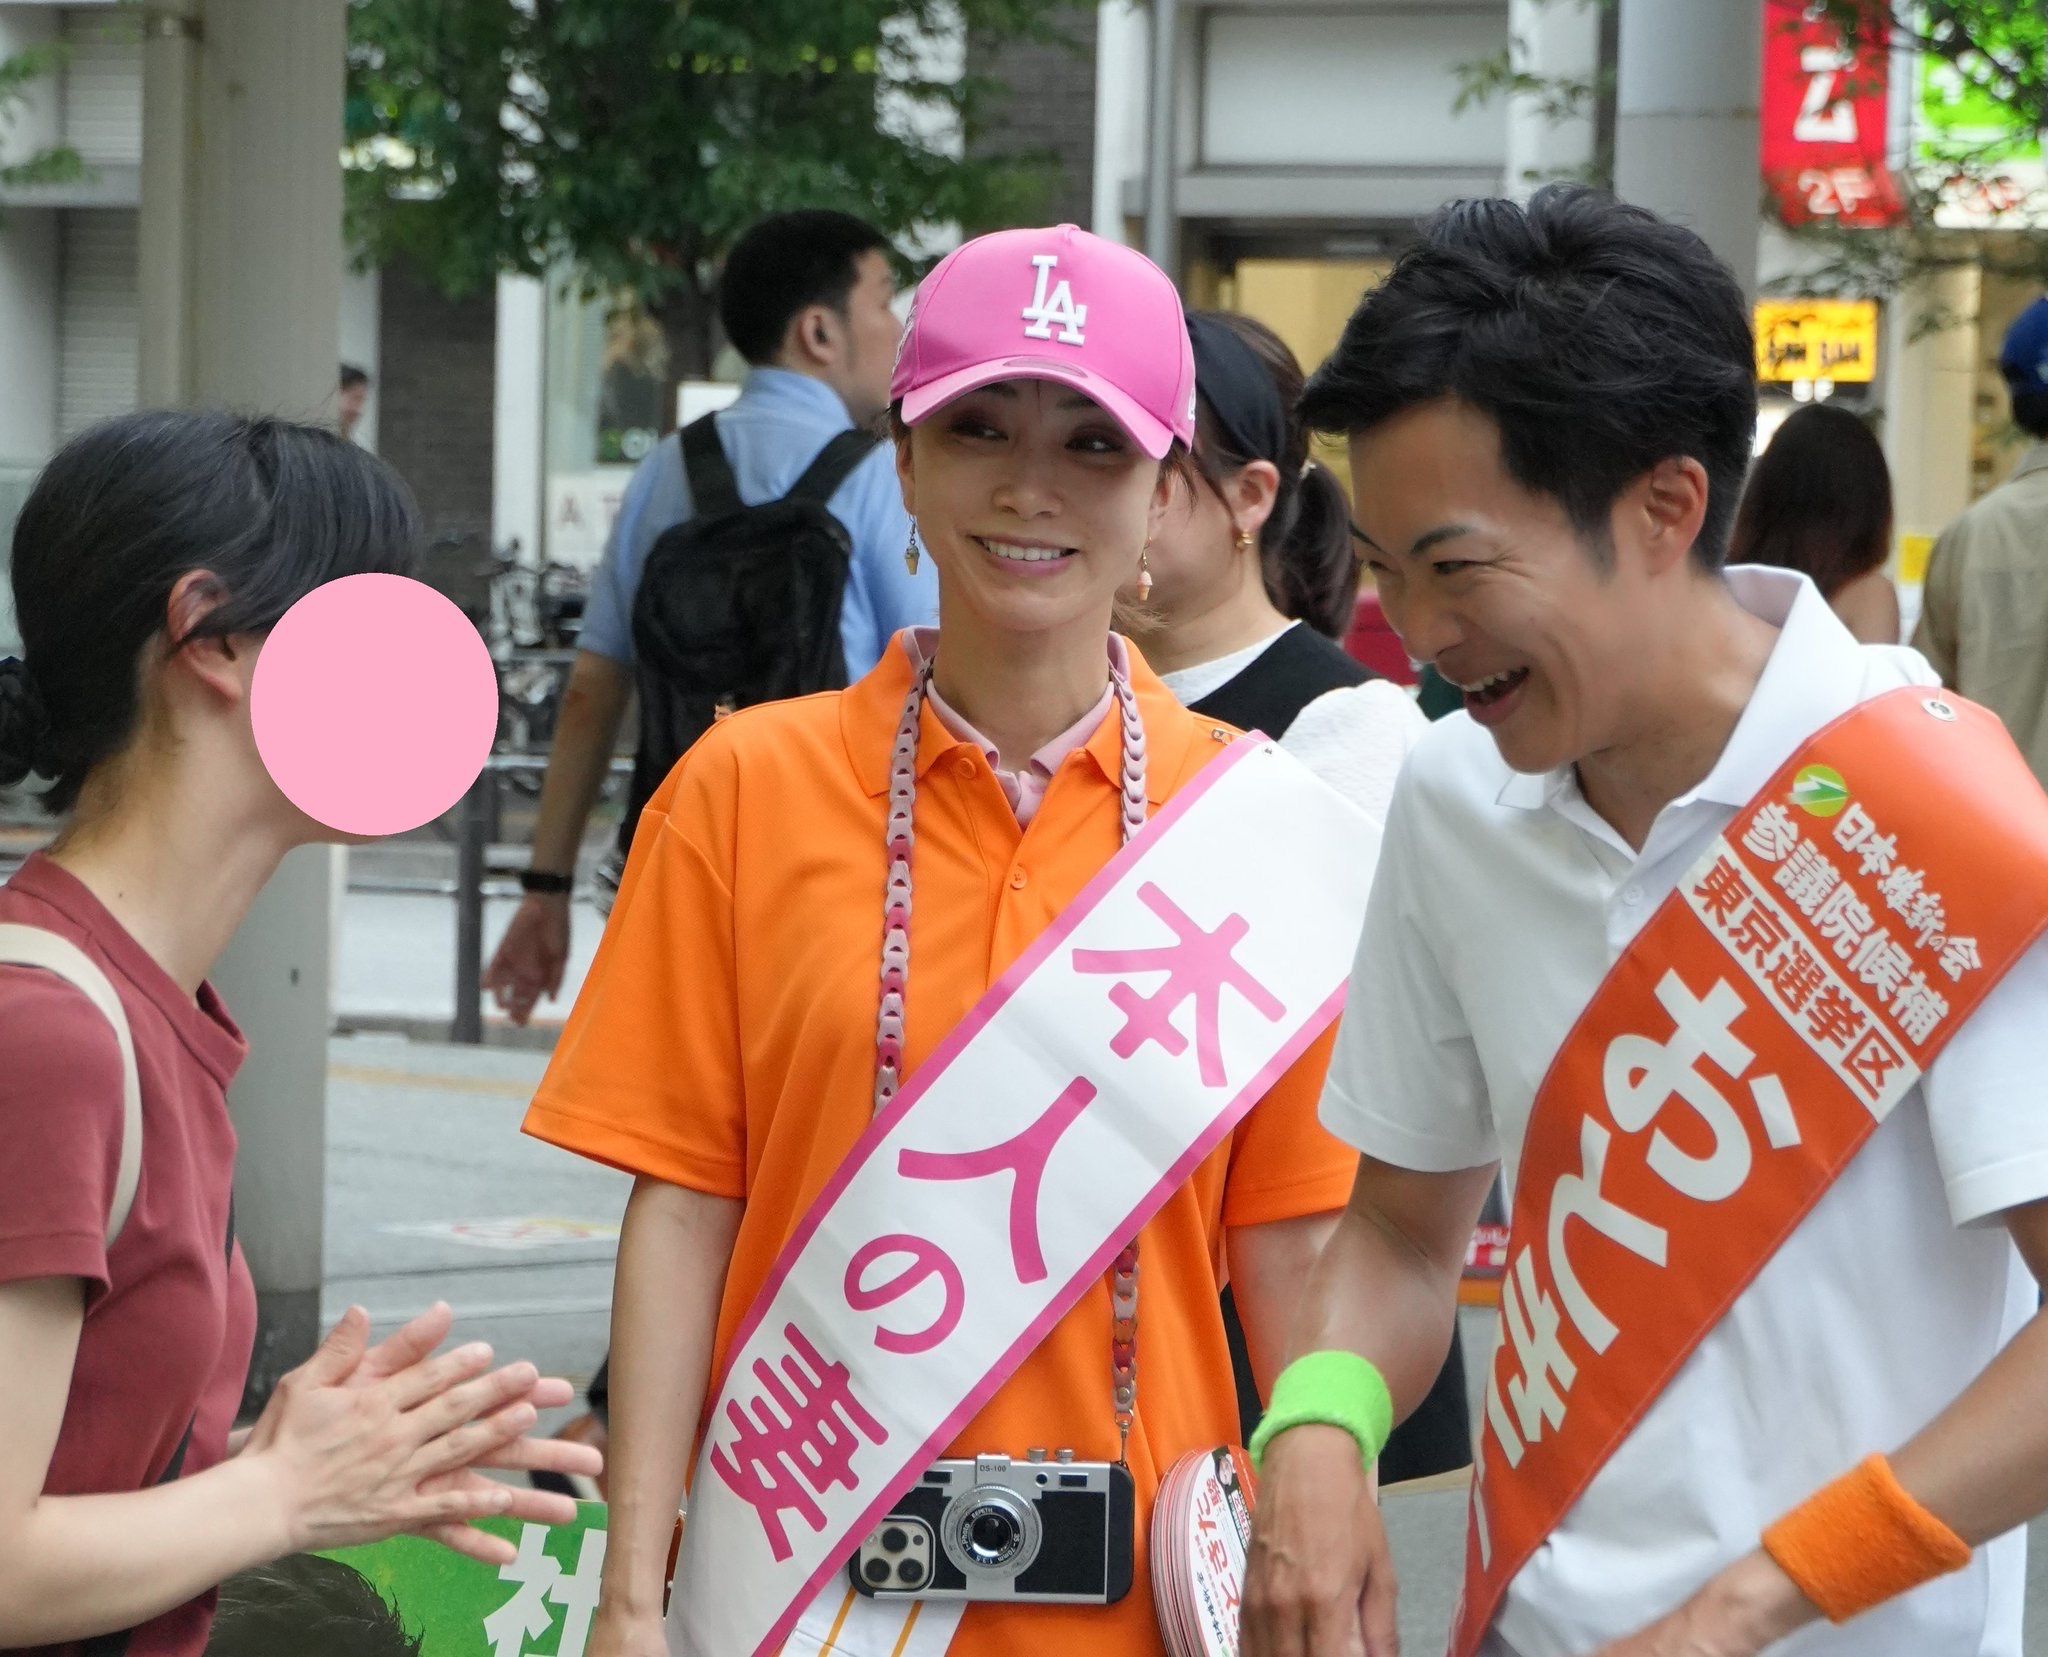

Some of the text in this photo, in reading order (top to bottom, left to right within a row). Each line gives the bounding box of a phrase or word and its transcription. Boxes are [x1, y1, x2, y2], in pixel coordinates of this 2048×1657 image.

[1021, 255, 1087, 346] LA
[1694, 855, 1905, 1101] 東京選挙区
[1741, 803, 1950, 1045] 参議院候補
[1833, 802, 1982, 983] 日本維新の会
[710, 881, 1286, 1562] 本人の妻
[1474, 968, 1801, 1572] おとき
[980, 1465, 1007, 1473] DS-100
